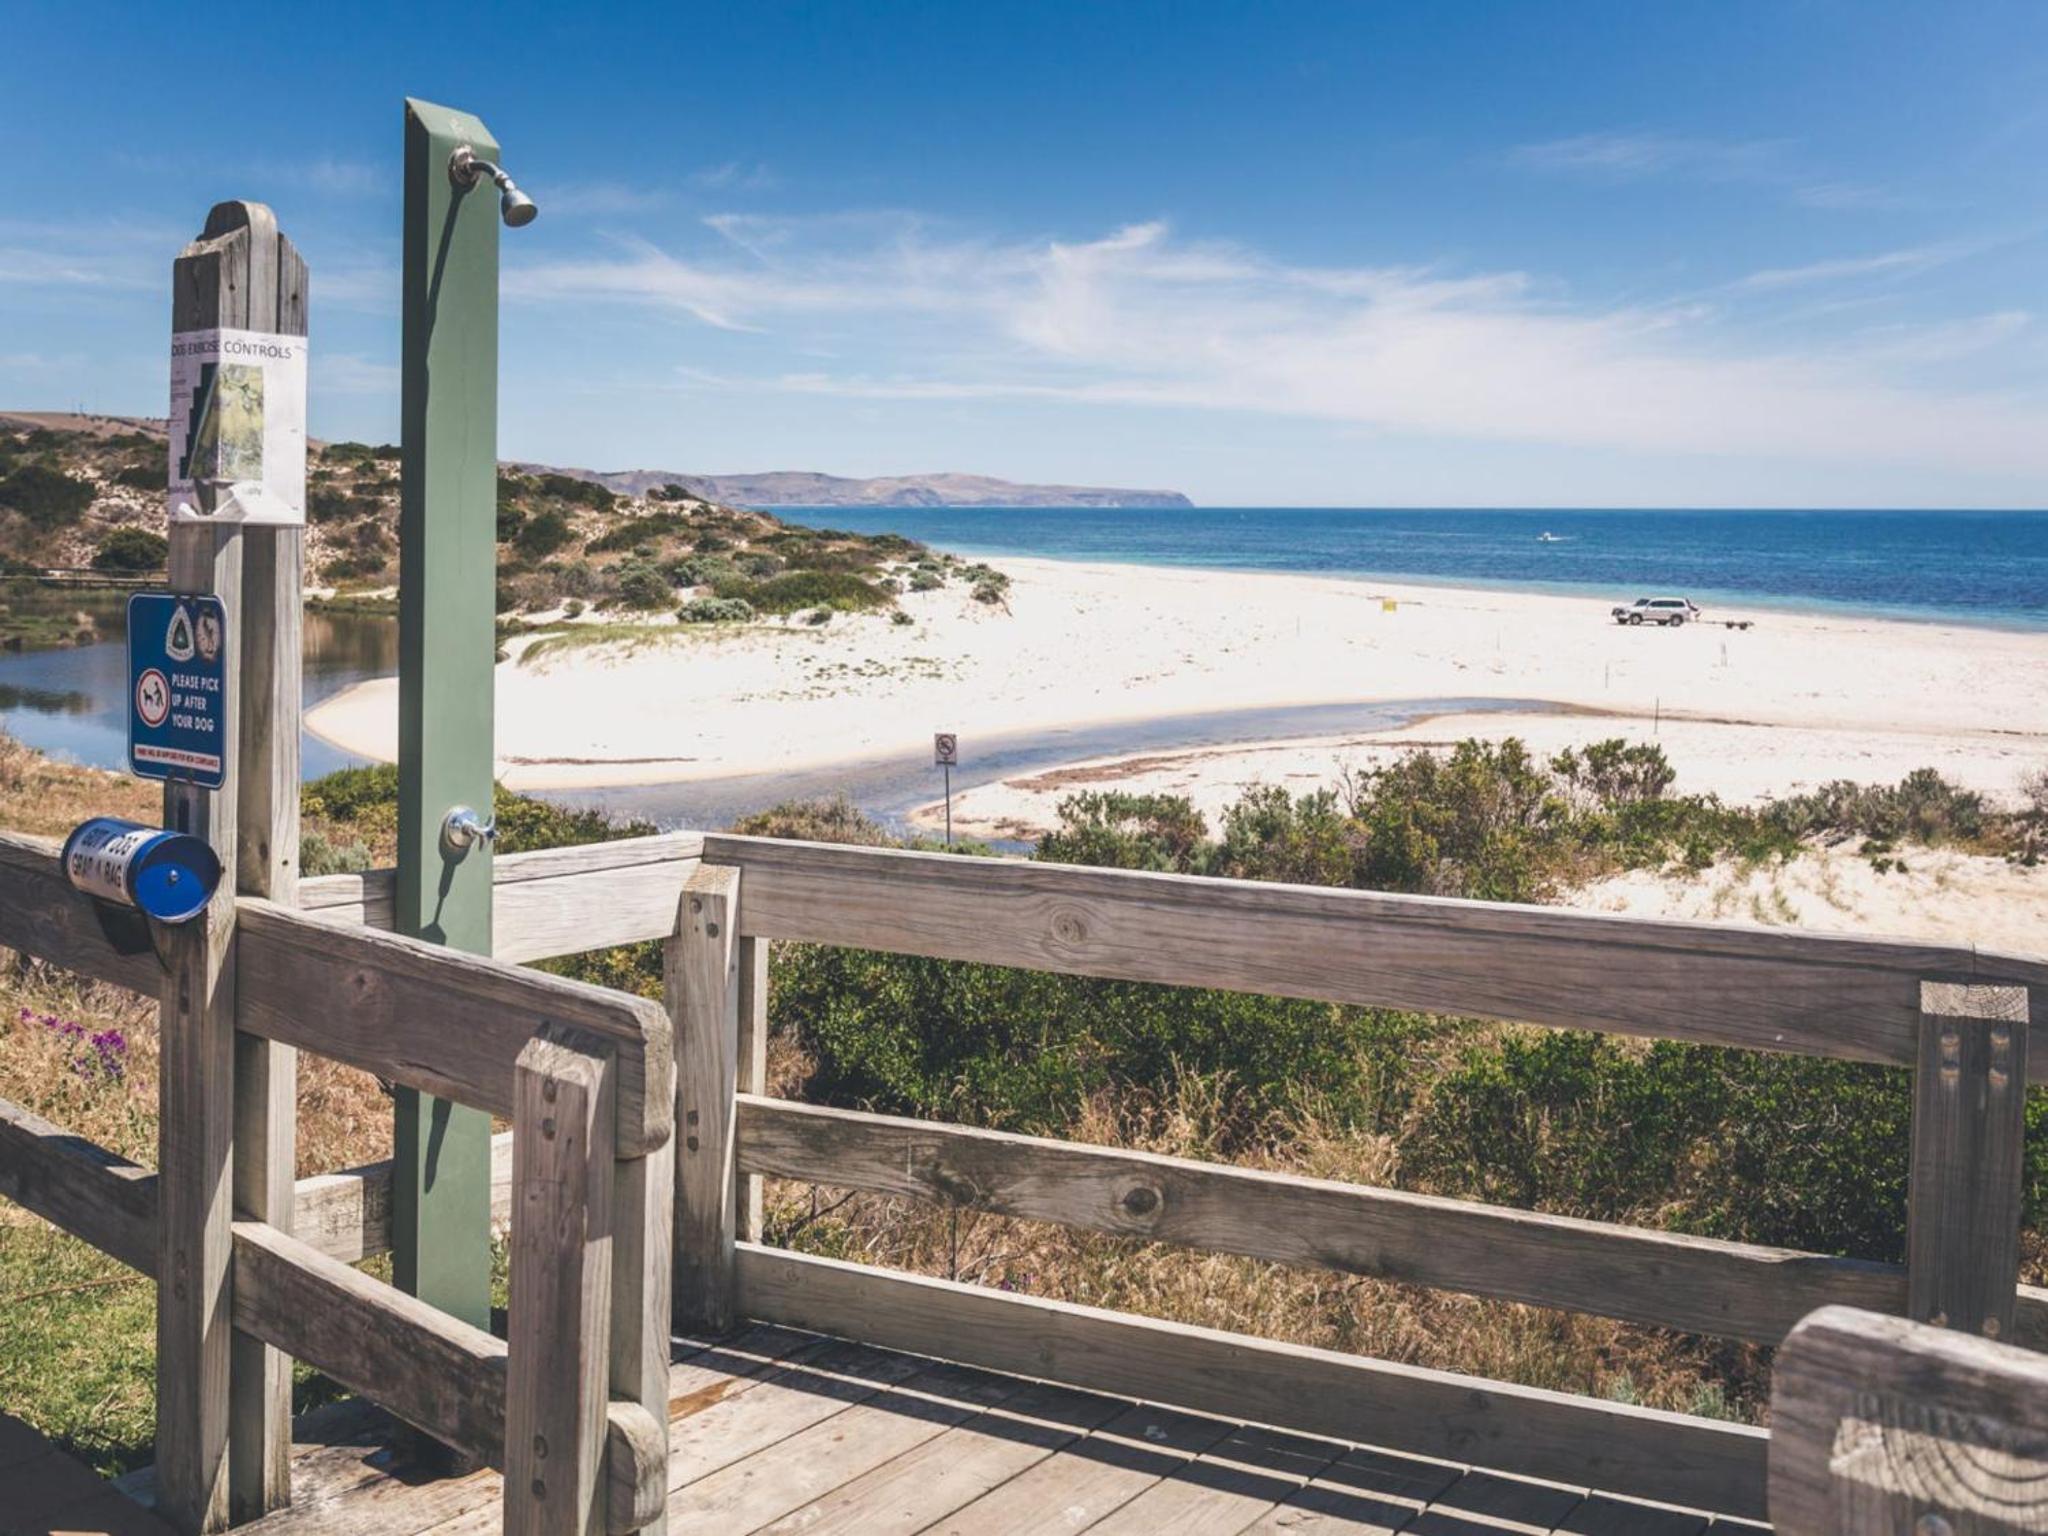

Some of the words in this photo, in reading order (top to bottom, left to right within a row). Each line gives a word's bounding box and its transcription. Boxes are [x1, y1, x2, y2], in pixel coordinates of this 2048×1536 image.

[224, 340, 292, 360] CONTROLS
[172, 674, 199, 689] PLEASE
[201, 677, 219, 691] PICK
[172, 694, 182, 707] UP
[184, 695, 207, 711] AFTER
[172, 714, 193, 729] YOUR
[195, 717, 215, 732] DOG
